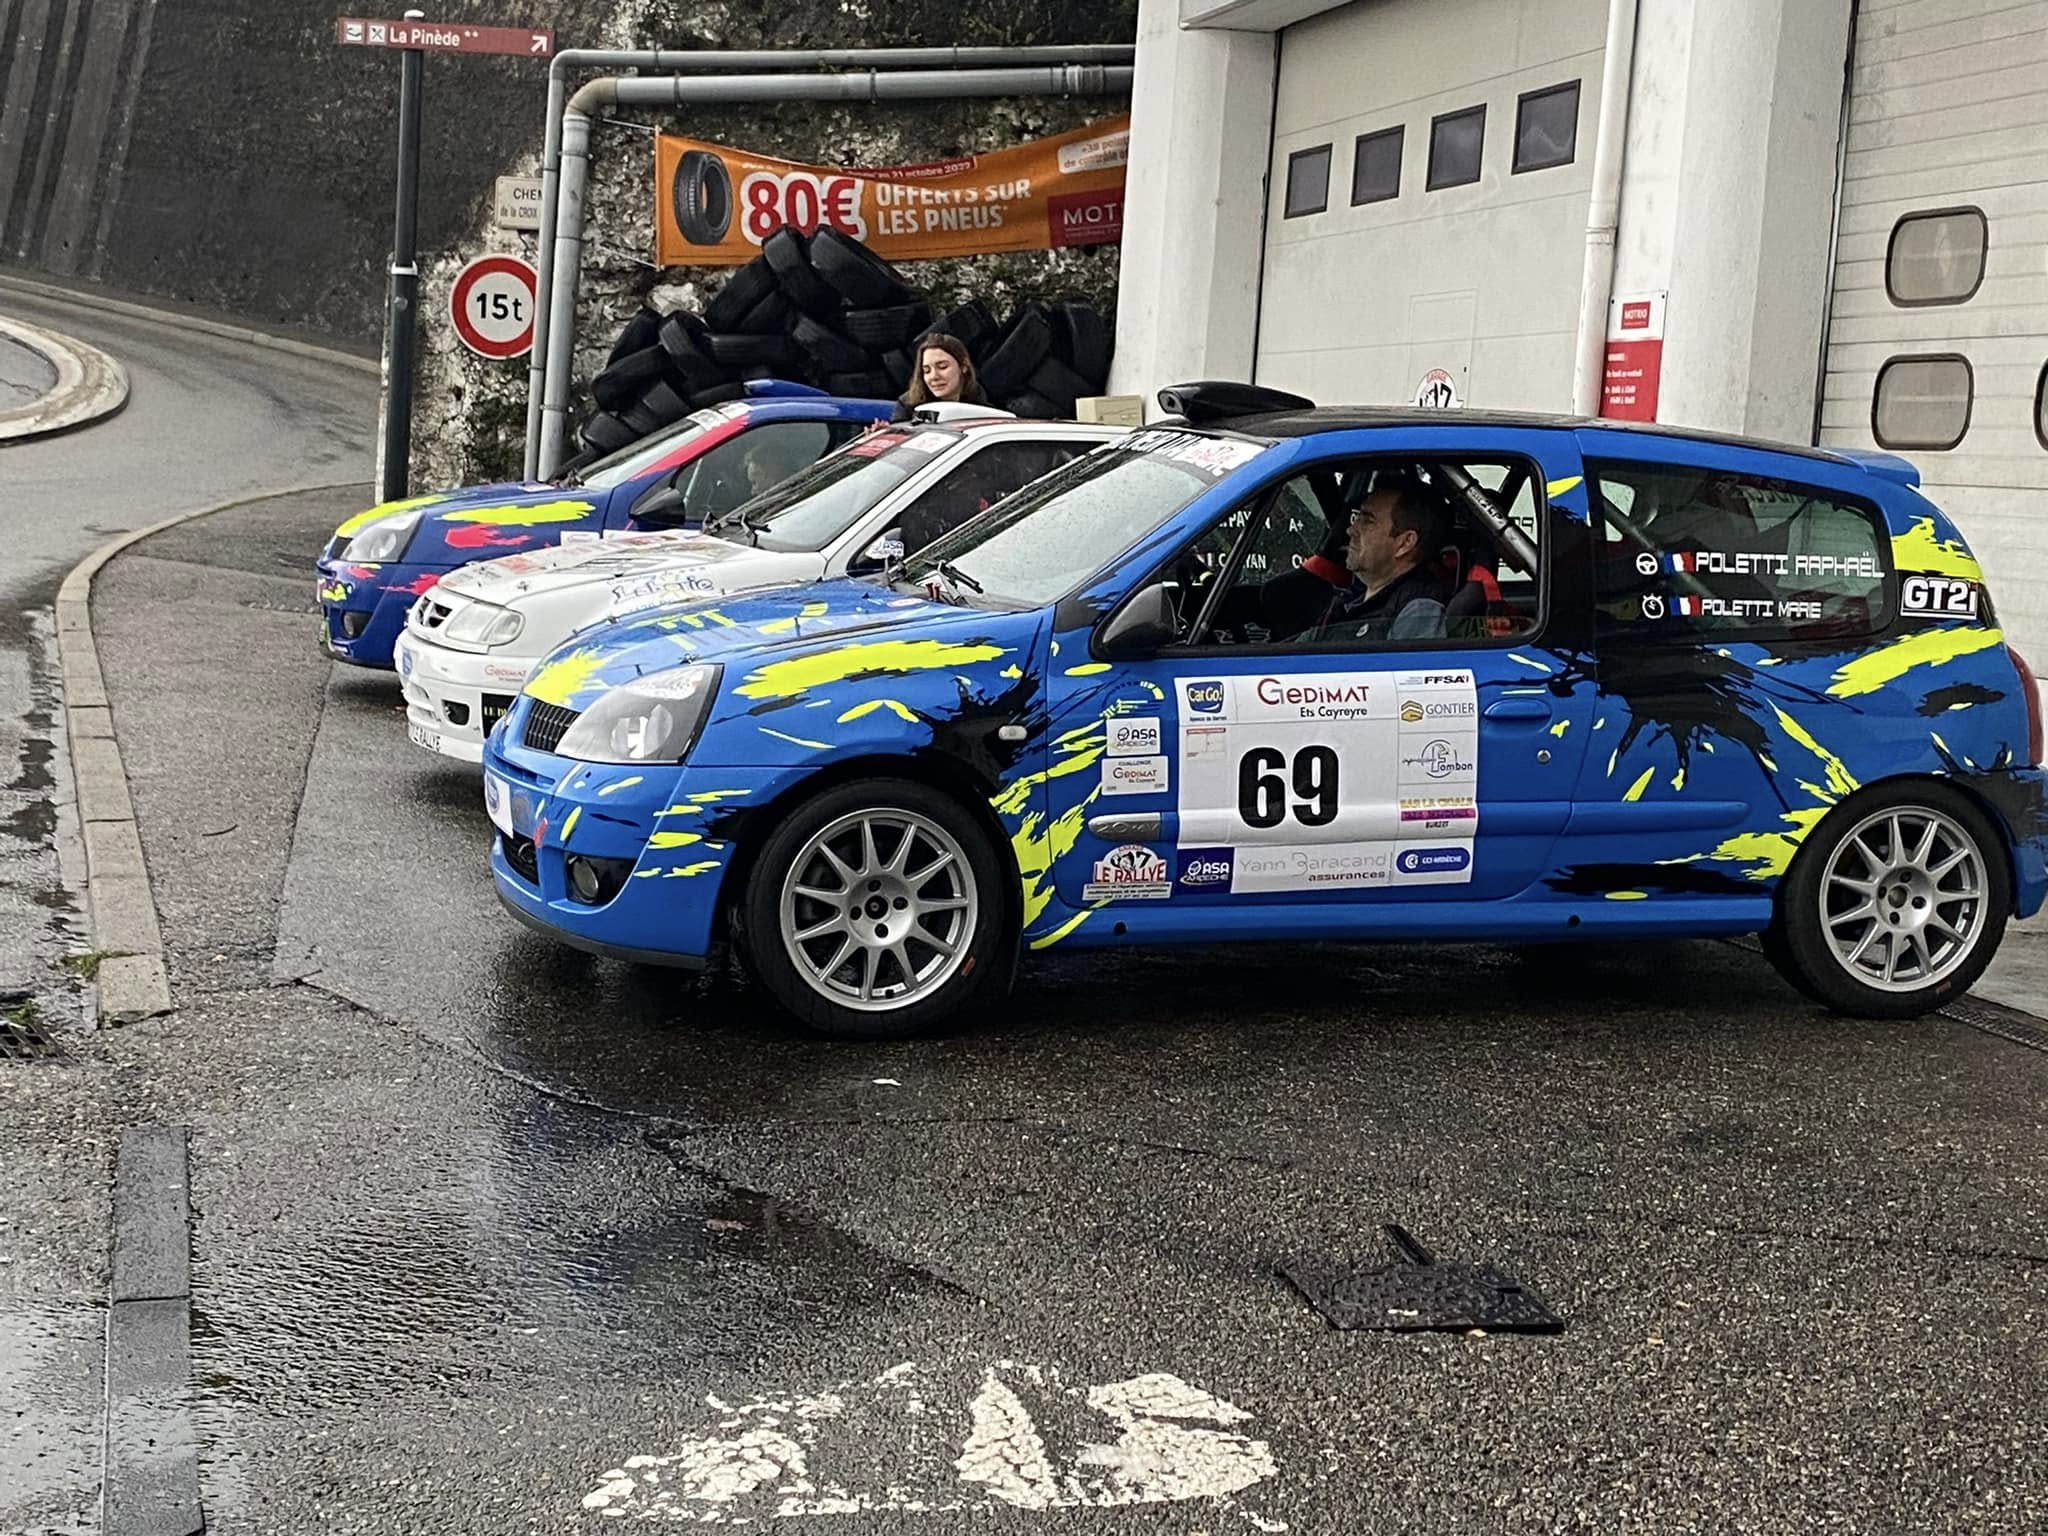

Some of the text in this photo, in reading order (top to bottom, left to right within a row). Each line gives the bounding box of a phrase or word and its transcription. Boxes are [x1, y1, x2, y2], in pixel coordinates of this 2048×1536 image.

[390, 26, 460, 47] La Pinède
[875, 178, 1031, 207] OFFERTS SUR
[747, 178, 860, 239] 80€
[877, 209, 919, 236] LES
[1695, 551, 1886, 579] POLETTI RAPHAËL
[1701, 599, 1774, 617] POLETTI
[1424, 675, 1465, 685] FFSA
[1300, 705, 1368, 720] Ets Cayreyre
[1425, 703, 1475, 716] GONTIER
[1131, 728, 1158, 740] ASA
[1238, 745, 1340, 829] 69
[1094, 861, 1166, 883] LE RALLYE
[1202, 861, 1230, 874] ASA
[1239, 858, 1287, 873] Yann
[1308, 870, 1386, 882] assurances
